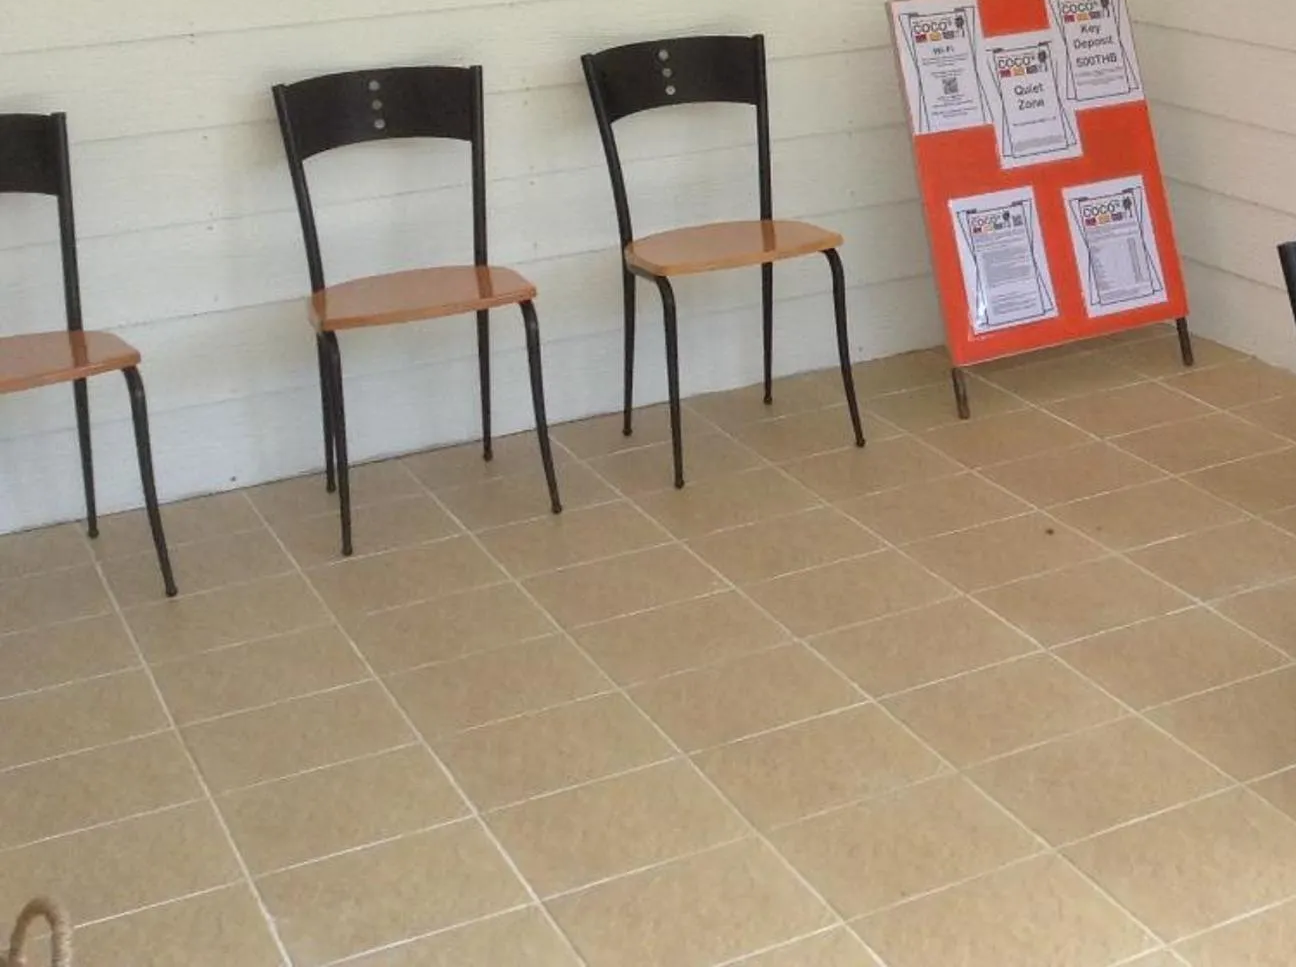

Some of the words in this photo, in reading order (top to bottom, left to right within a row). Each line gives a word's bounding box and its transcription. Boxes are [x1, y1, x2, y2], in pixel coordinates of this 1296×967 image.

[1080, 24, 1101, 34] Key
[1073, 35, 1114, 49] Deposit
[1014, 82, 1044, 96] Quiet
